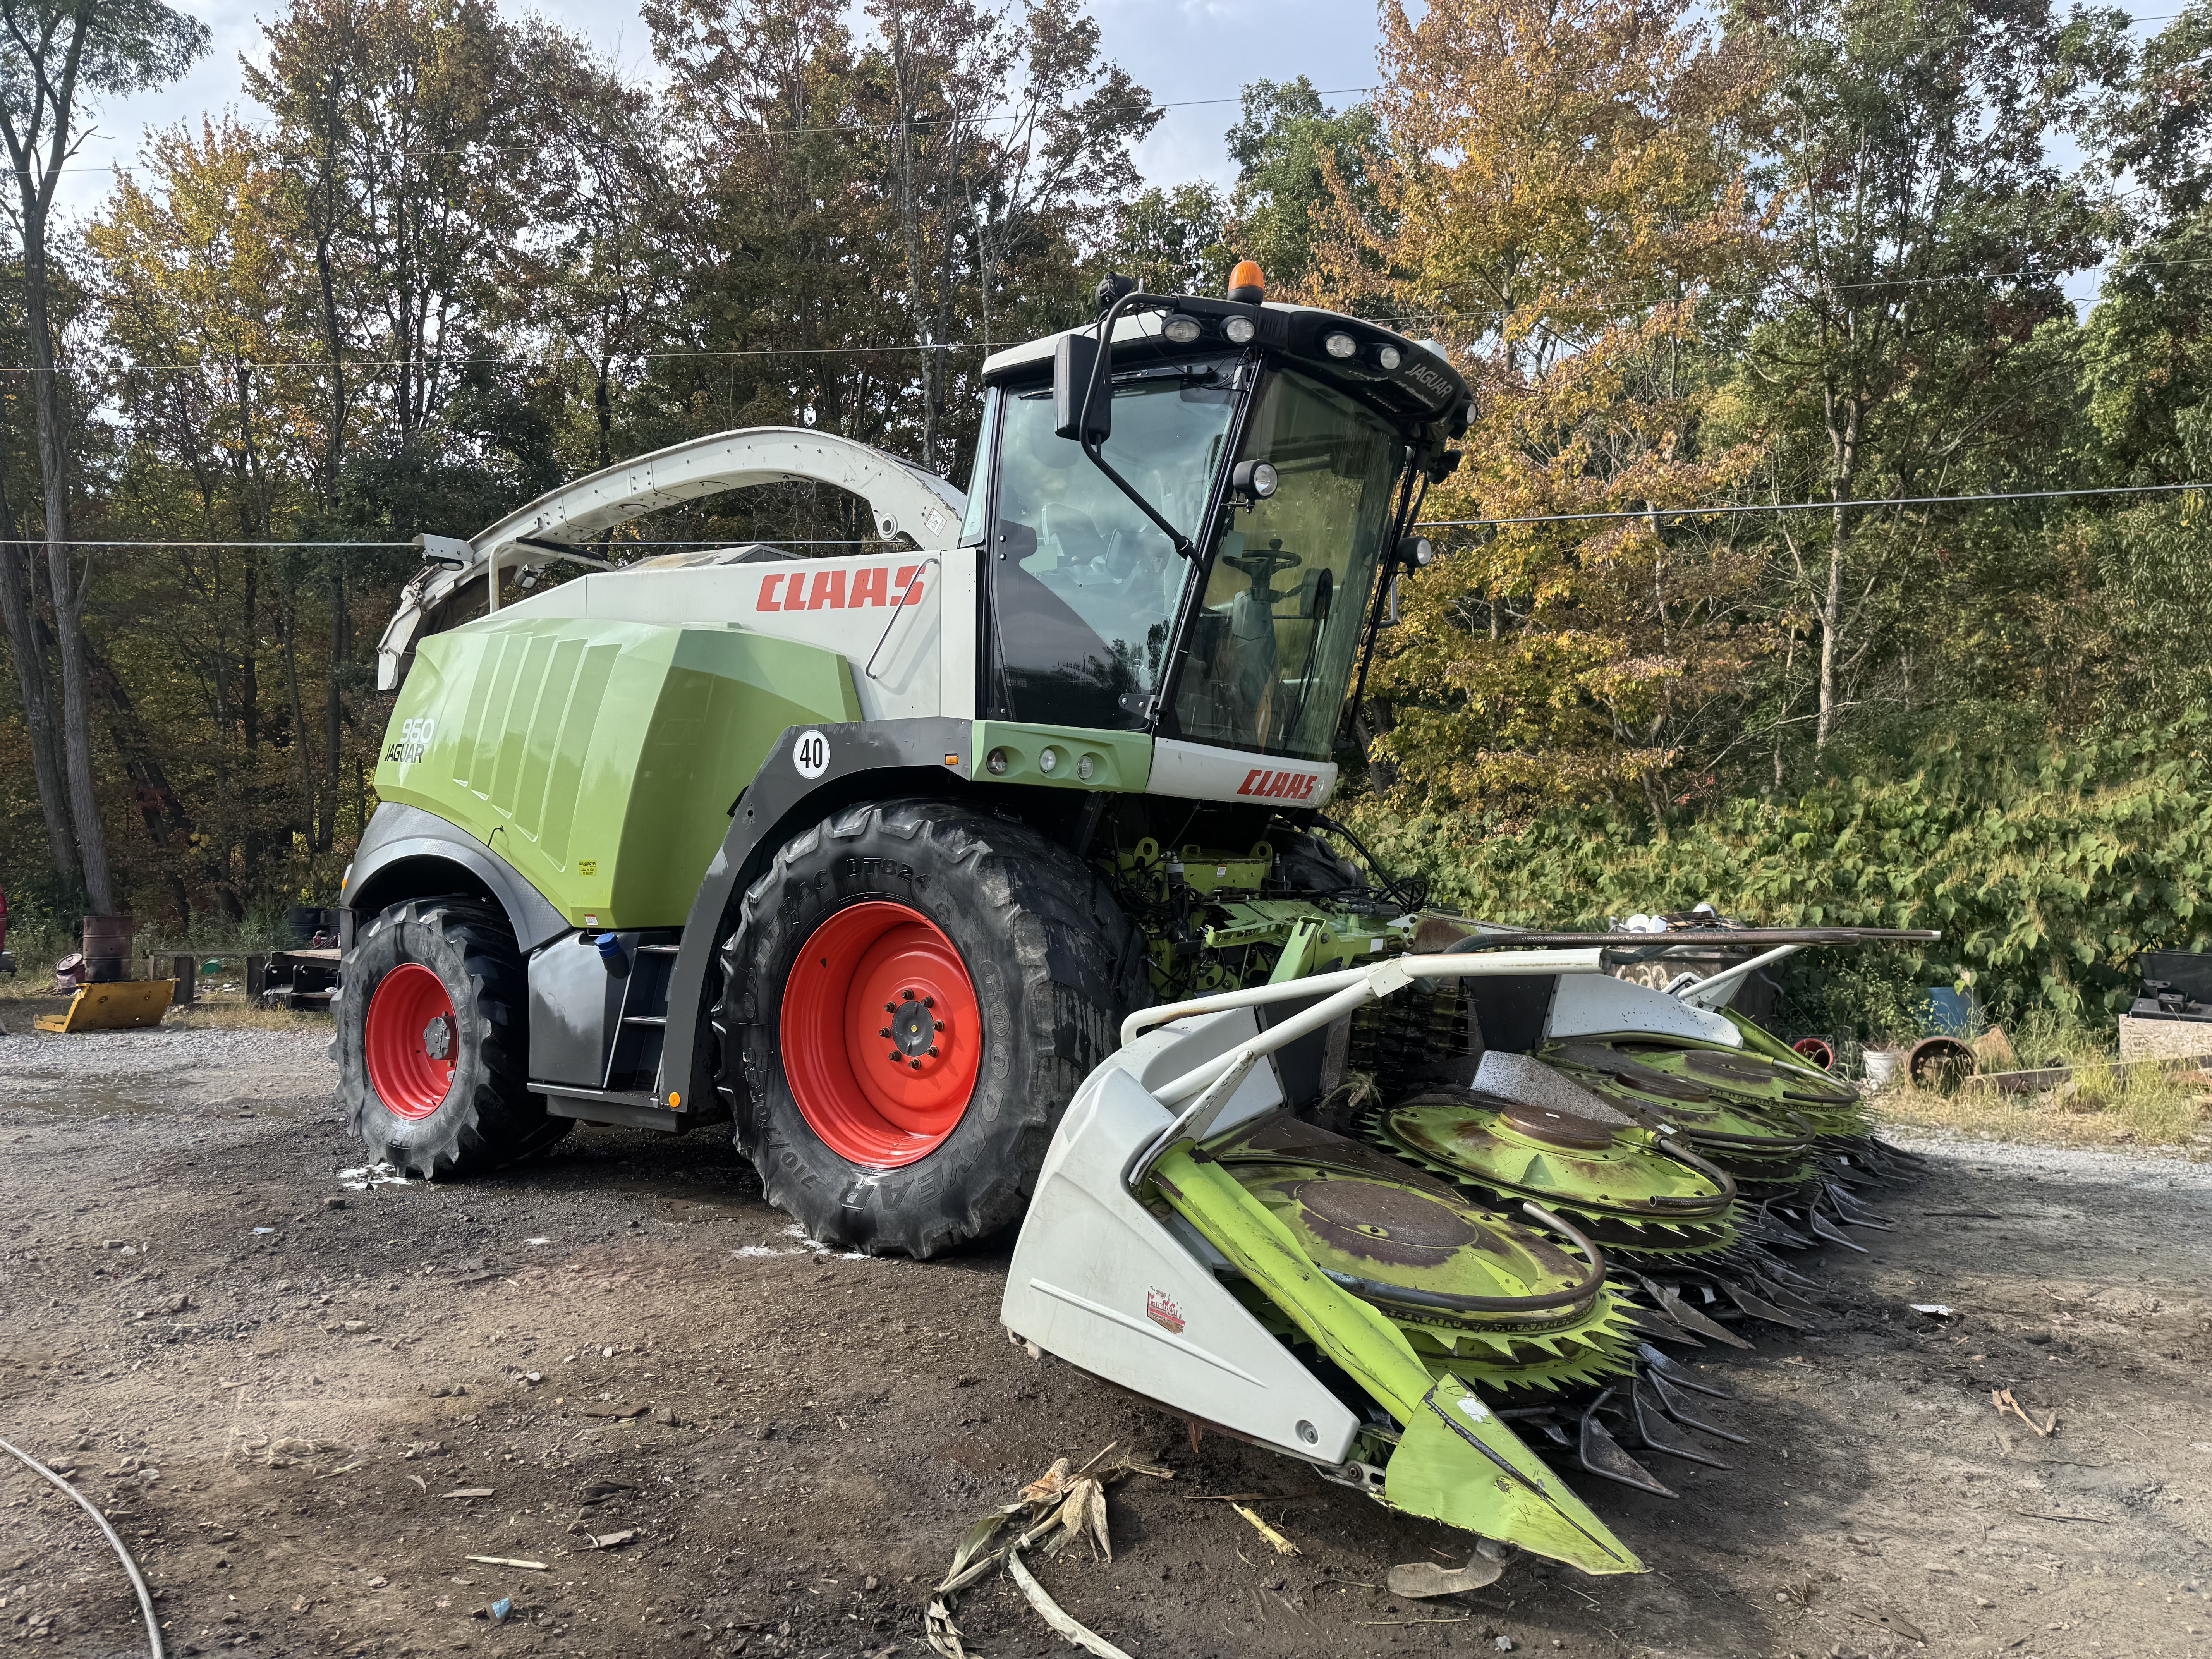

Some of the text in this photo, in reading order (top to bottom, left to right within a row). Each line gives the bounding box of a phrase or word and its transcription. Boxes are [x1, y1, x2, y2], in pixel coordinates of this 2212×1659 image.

[1404, 363, 1453, 398] JAGUAR
[756, 565, 927, 612] CLAAS
[399, 718, 435, 744] 960
[384, 744, 425, 764] JAGUAR
[800, 738, 823, 769] 40
[1237, 769, 1318, 799] CLAAS
[846, 857, 932, 891] DT824
